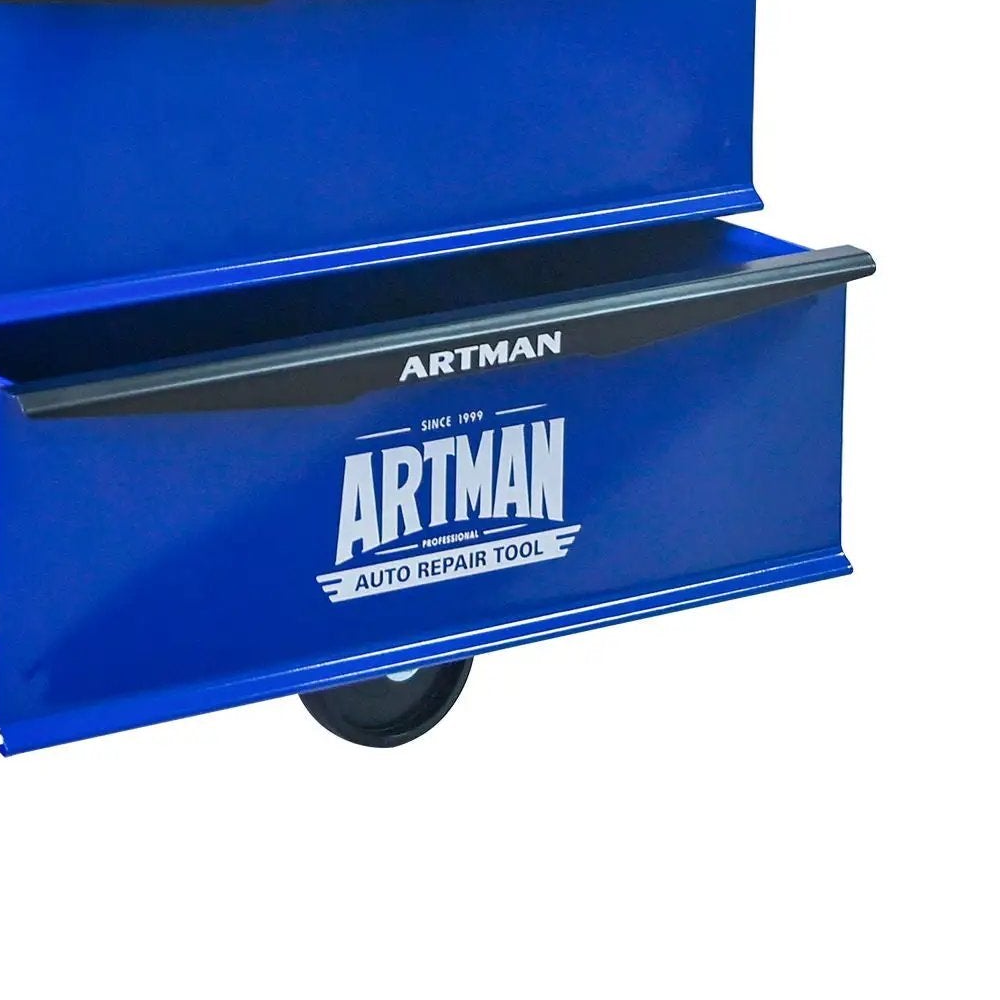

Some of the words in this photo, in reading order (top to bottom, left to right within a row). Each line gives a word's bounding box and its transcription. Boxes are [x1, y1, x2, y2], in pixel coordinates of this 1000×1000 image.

[399, 330, 562, 382] ARTMAN
[421, 415, 452, 431] SINCE
[458, 410, 484, 425] 1999
[334, 417, 565, 566] ARTMAN
[422, 529, 479, 548] PROFESSIONAL
[354, 564, 412, 592] AUTO
[417, 551, 487, 578] REPAIR
[493, 540, 544, 564] TOOL
